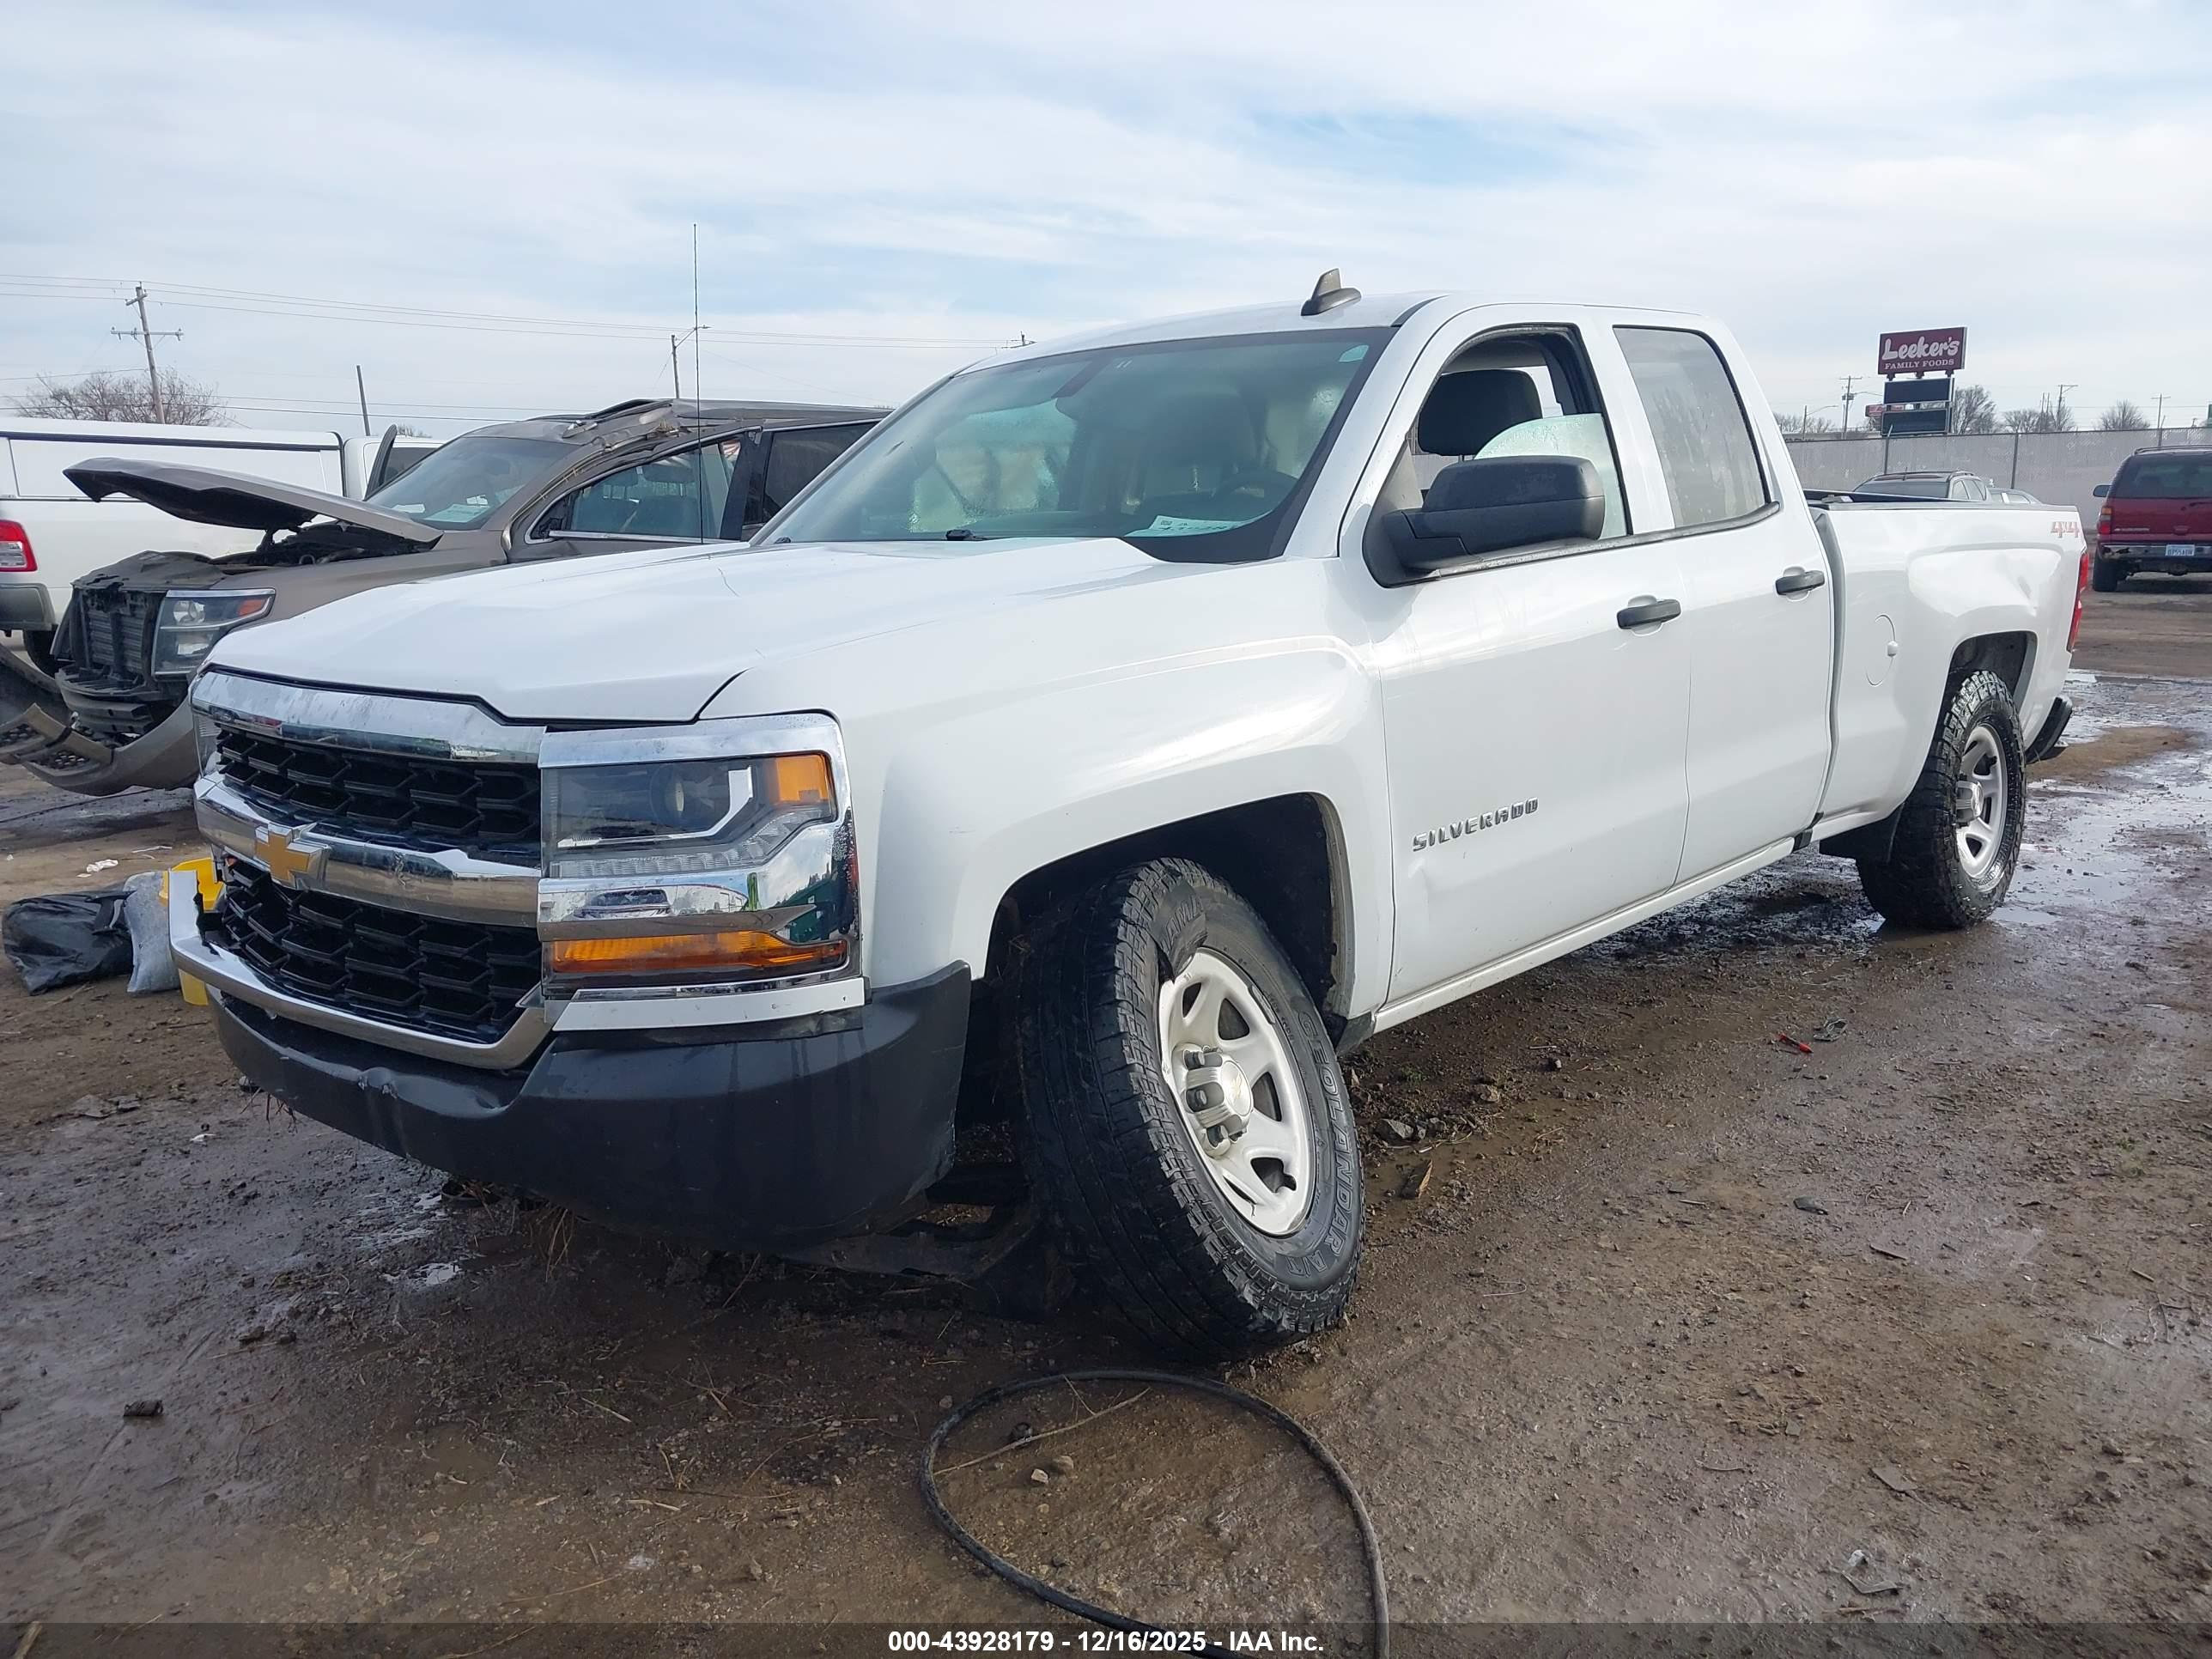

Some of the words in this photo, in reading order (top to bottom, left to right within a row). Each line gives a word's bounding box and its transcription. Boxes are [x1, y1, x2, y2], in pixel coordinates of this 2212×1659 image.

[1881, 336, 1960, 361] Leeker's
[1884, 361, 1920, 370] FAMILY
[1923, 358, 1954, 368] FOODS
[1413, 797, 1539, 852] SILVERADO
[1298, 1010, 1355, 1256] GEOLANDAR
